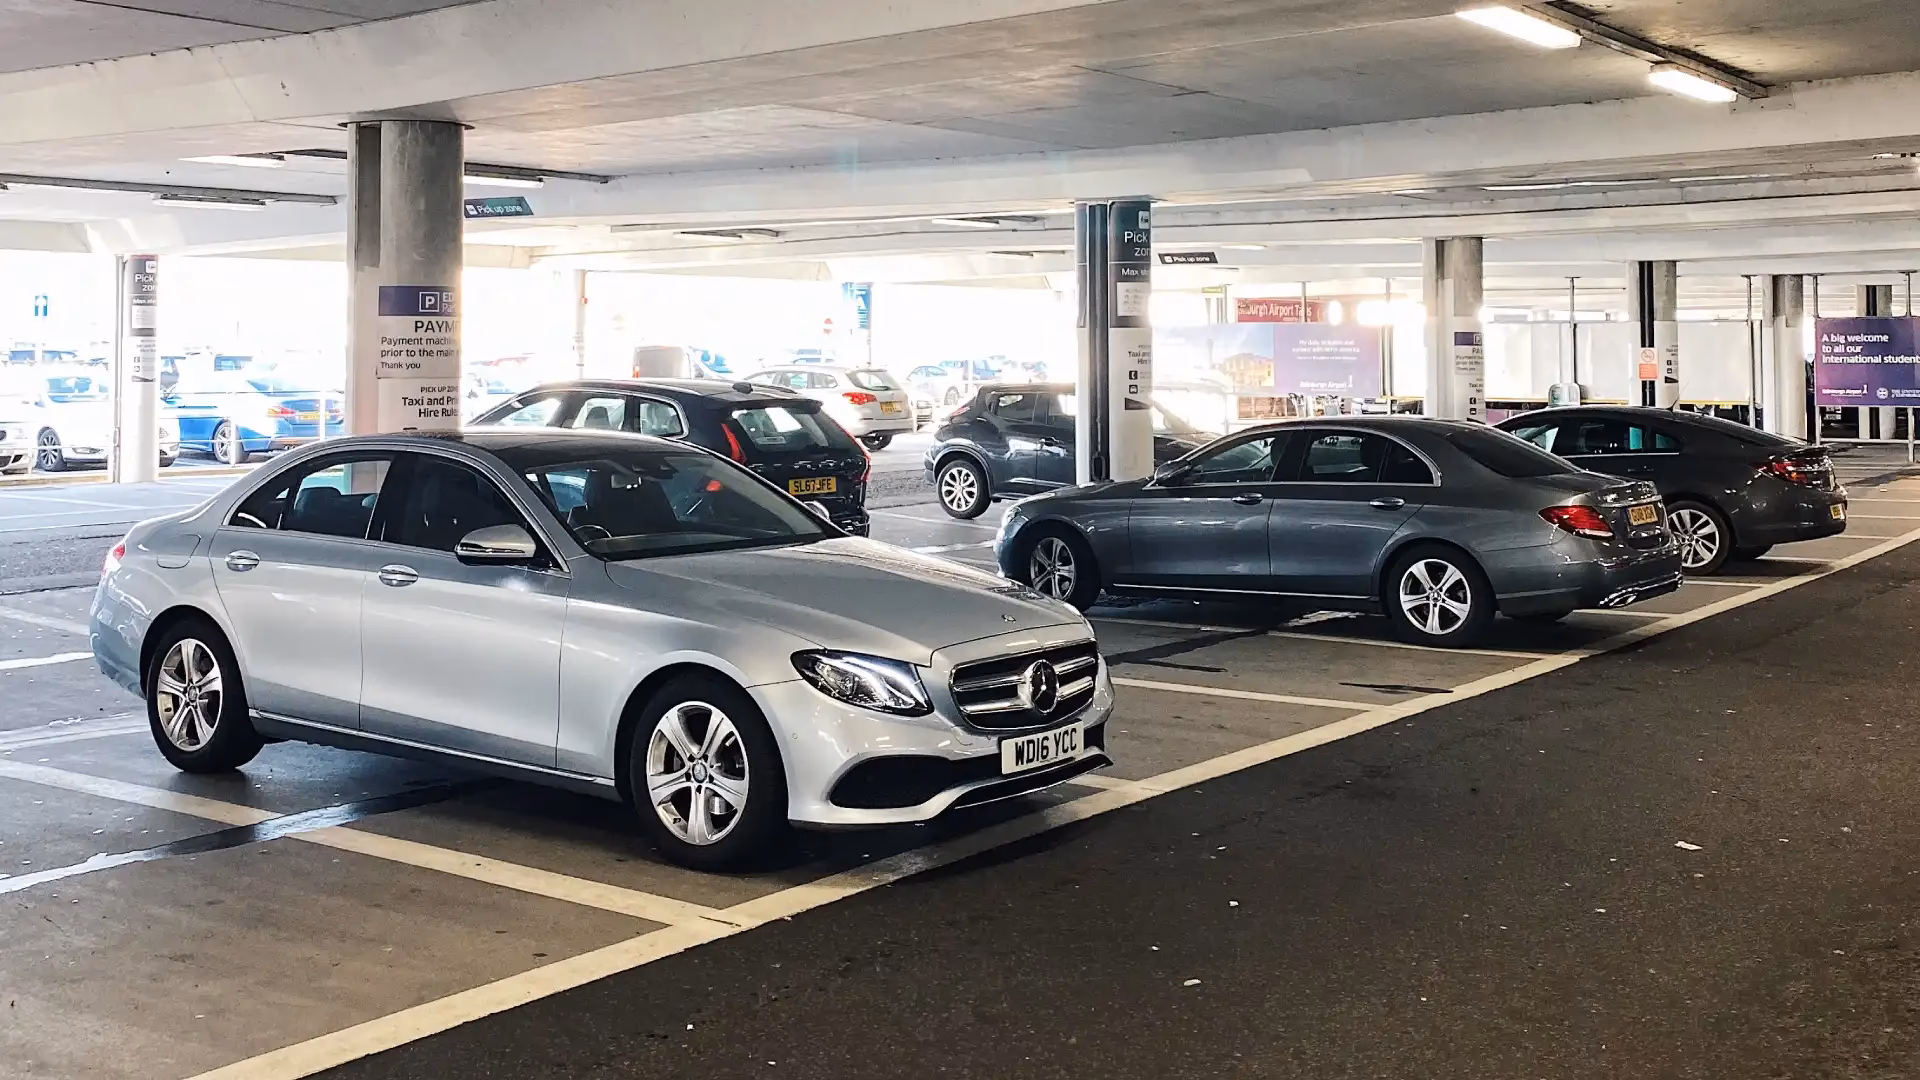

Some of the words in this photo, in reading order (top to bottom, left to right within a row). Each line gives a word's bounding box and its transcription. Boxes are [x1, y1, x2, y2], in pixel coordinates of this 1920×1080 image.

[477, 204, 494, 214] Pick
[1124, 231, 1148, 243] Pick
[1121, 268, 1139, 276] Max
[135, 274, 154, 283] Pick
[1269, 302, 1294, 318] Airport
[380, 336, 423, 347] Payment
[1821, 334, 1829, 343] A
[1830, 333, 1846, 344] big
[1847, 333, 1889, 343] welcome
[380, 348, 404, 358] prior
[406, 349, 416, 357] to
[419, 348, 435, 357] the
[1821, 345, 1832, 353] to
[1833, 344, 1845, 353] all
[1846, 345, 1863, 353] our
[380, 361, 404, 369] Thank
[420, 385, 436, 393] PICK
[437, 385, 446, 393] UP
[402, 396, 425, 406] Taxi
[427, 396, 444, 406] and
[418, 408, 440, 418] Hire
[1014, 735, 1050, 767] WD16
[1053, 727, 1077, 757] YCC
